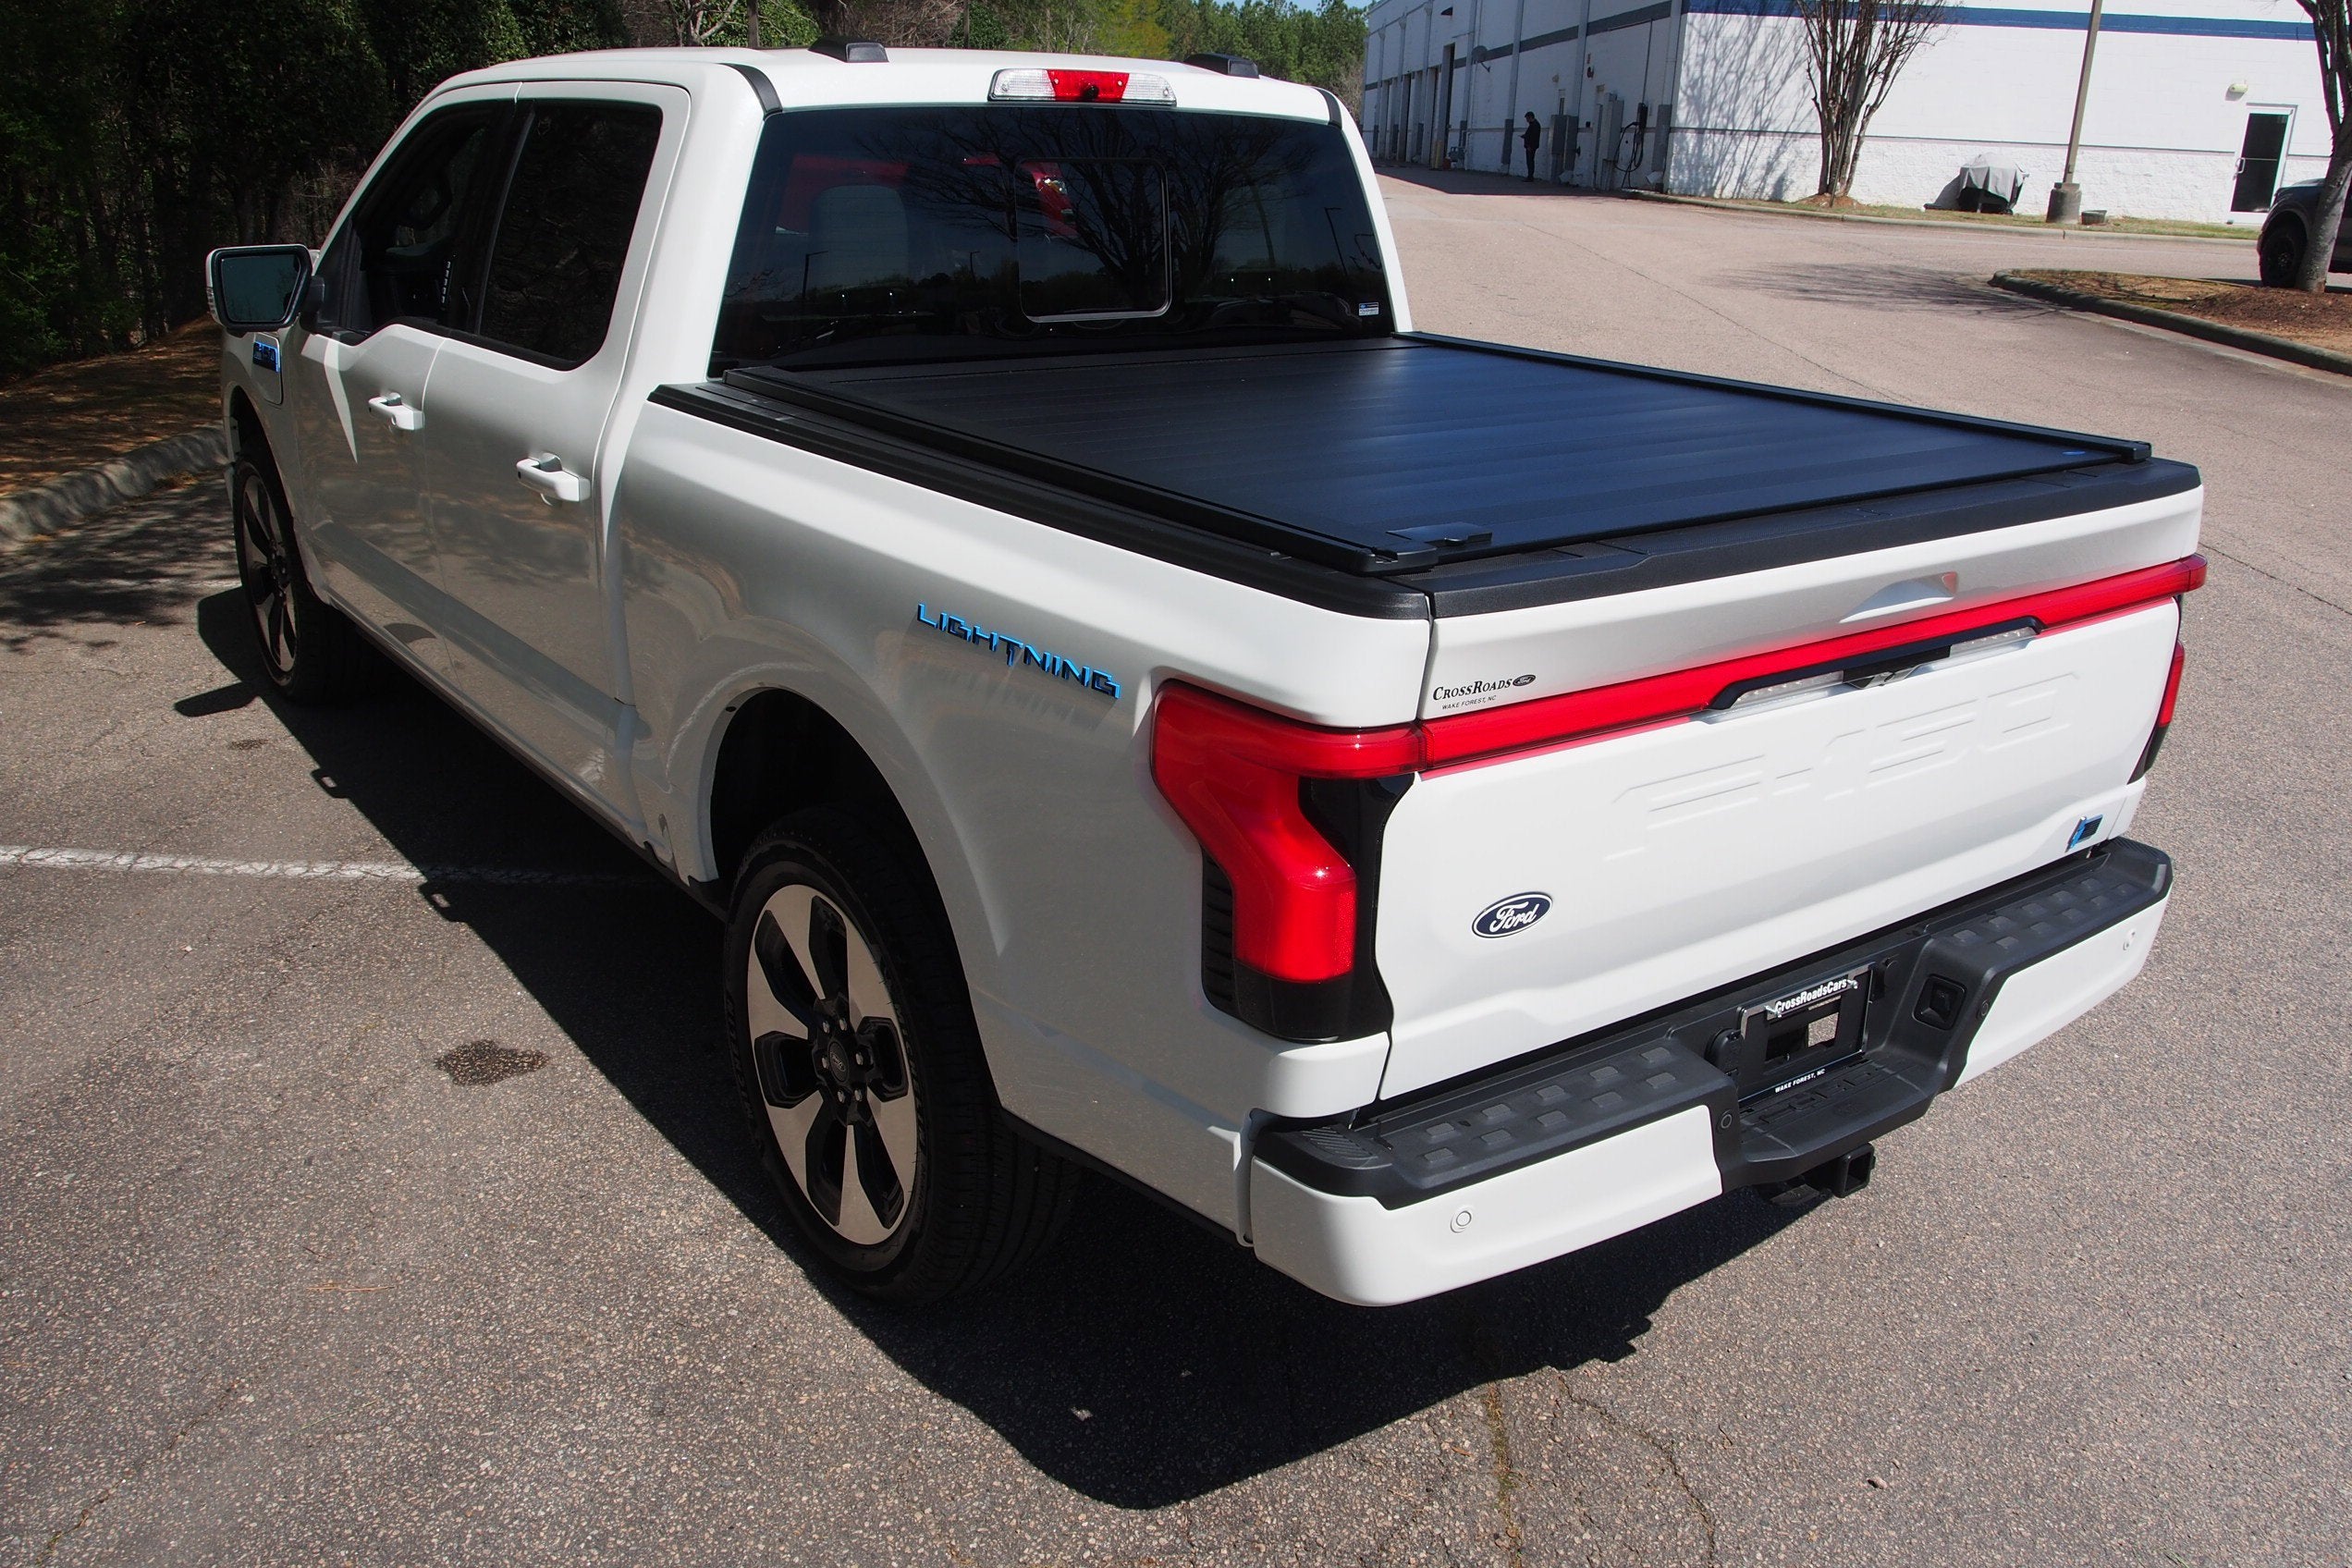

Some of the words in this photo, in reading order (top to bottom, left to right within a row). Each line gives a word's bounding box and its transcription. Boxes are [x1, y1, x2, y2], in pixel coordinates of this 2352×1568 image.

[916, 602, 1121, 699] LIGHTNING
[1441, 701, 1460, 710] WAKE
[1487, 694, 1497, 703] NC
[1774, 978, 1848, 1012] CrossRoadsCars
[1774, 1083, 1792, 1094] WAKE
[1817, 1068, 1826, 1078] NC
